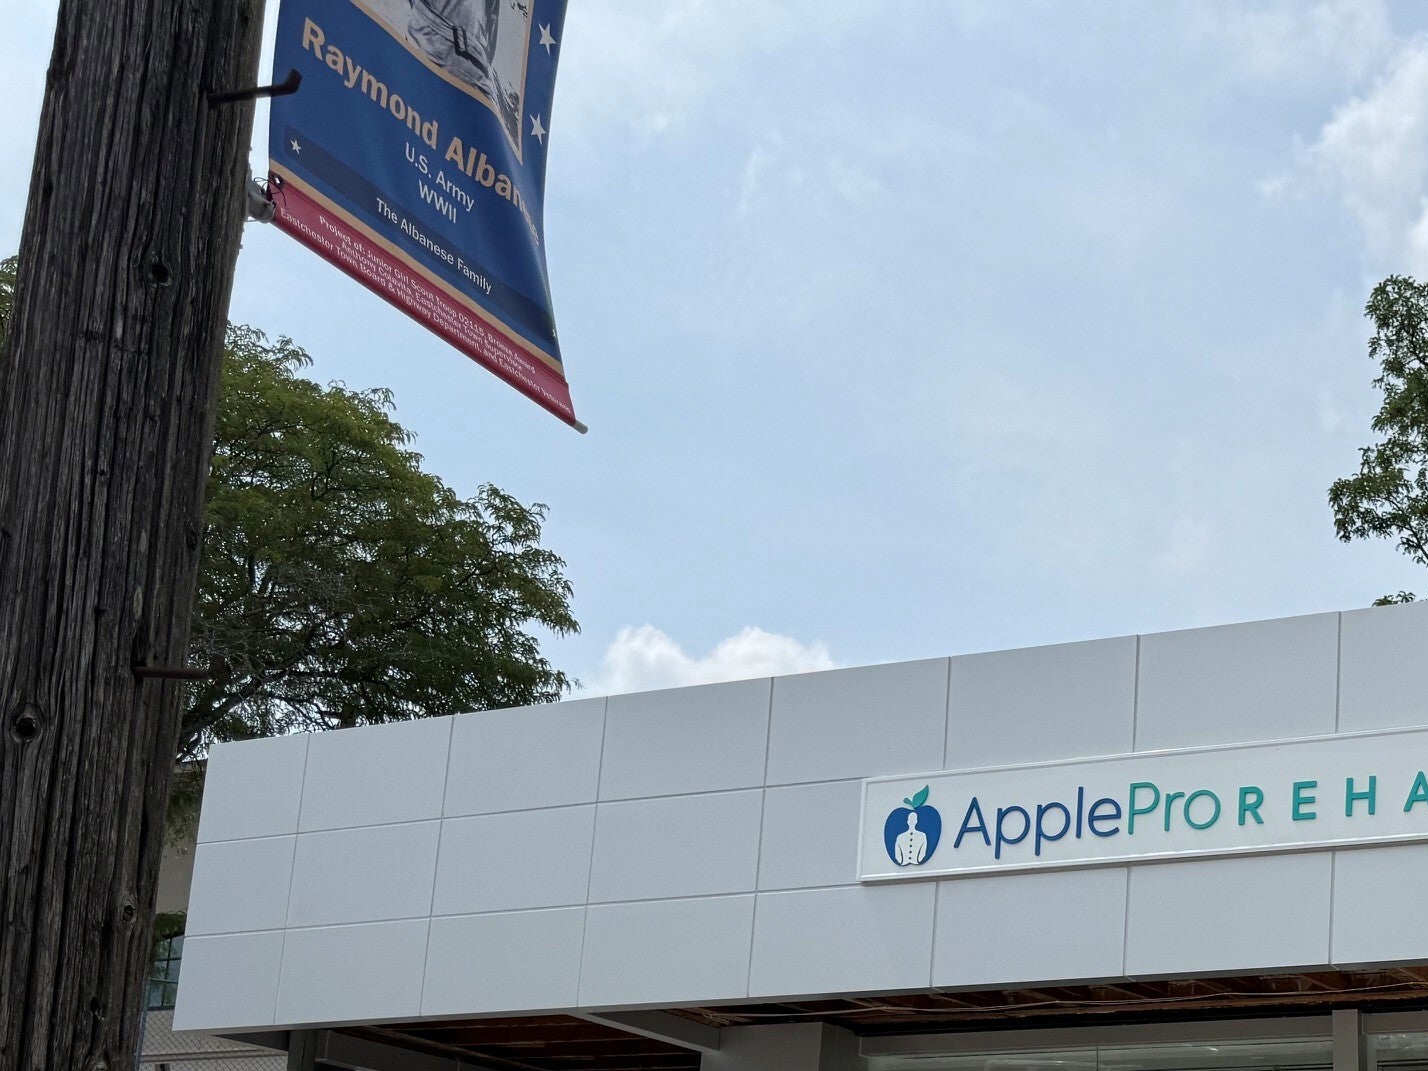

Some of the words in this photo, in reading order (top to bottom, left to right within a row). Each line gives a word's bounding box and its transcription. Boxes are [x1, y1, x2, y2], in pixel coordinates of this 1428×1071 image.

[303, 17, 439, 150] Raymond
[405, 142, 432, 178] U.S.
[436, 170, 475, 212] Army
[418, 179, 457, 223] WWII
[280, 207, 334, 251] Eastchester
[336, 245, 358, 268] Town
[360, 262, 386, 287] Board
[388, 282, 396, 293] &
[319, 215, 351, 245] Project
[368, 250, 393, 272] Junior
[394, 268, 409, 284] Girl
[410, 280, 435, 301] Scout
[435, 295, 458, 318] Troop
[341, 241, 376, 272] Anthony
[376, 197, 398, 223] The
[400, 218, 455, 265] Albanese
[457, 257, 492, 294] Family
